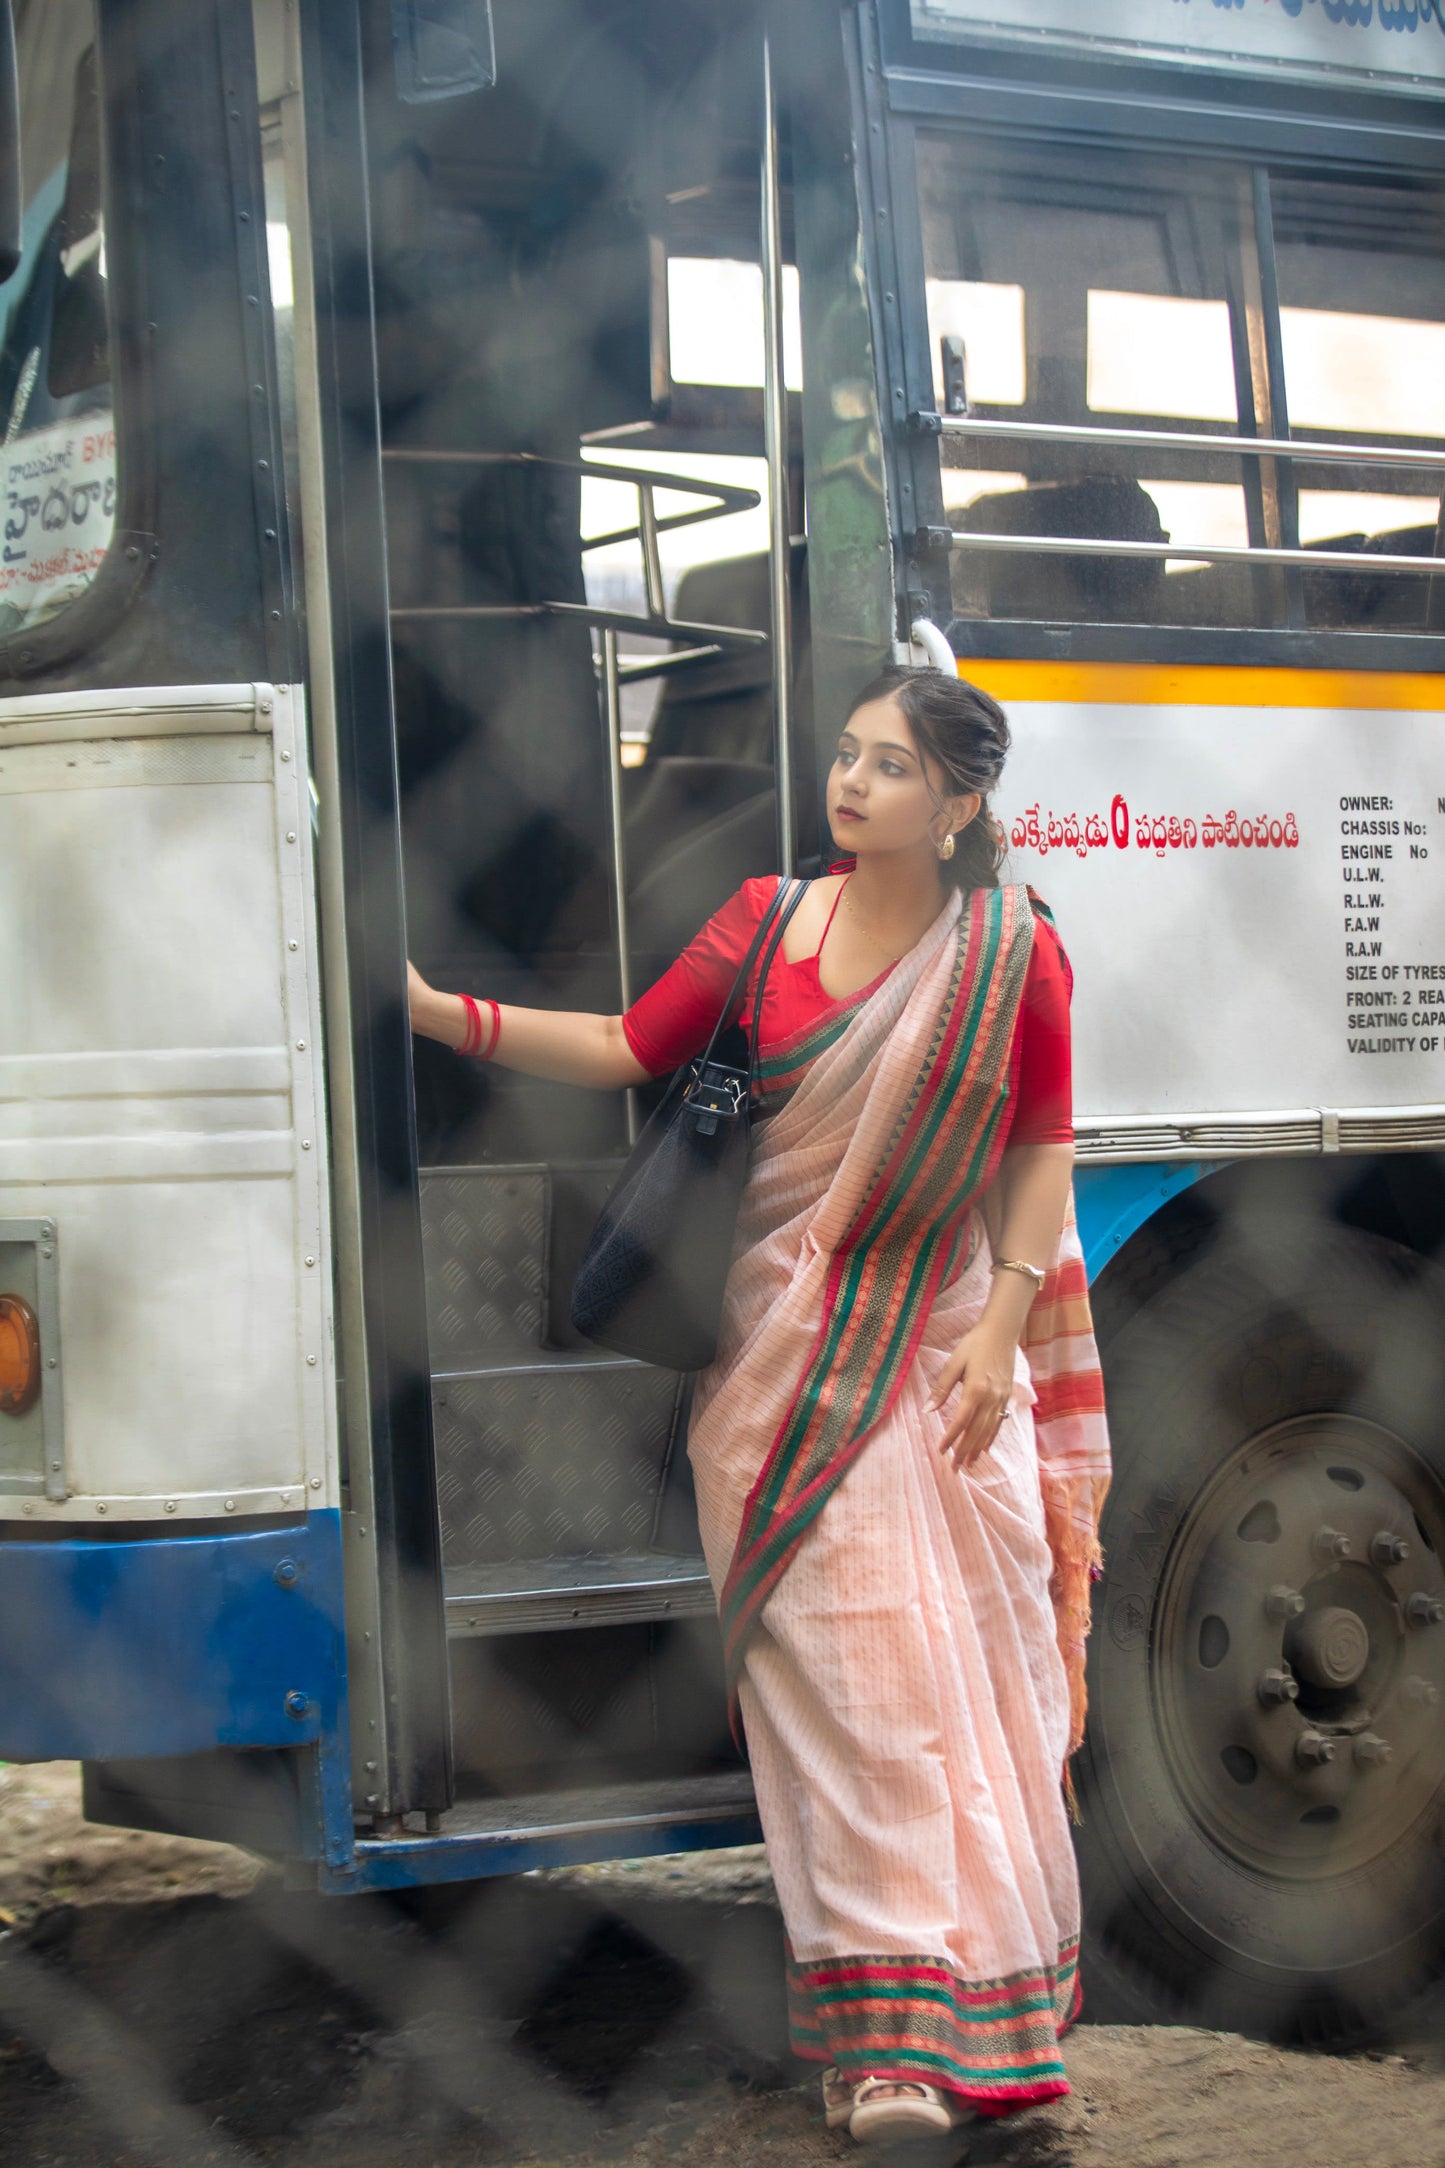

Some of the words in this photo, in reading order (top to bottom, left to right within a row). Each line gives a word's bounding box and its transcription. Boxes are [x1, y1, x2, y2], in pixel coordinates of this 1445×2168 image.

[1339, 796, 1394, 811] OWNER:
[1110, 793, 1130, 851] Q
[1341, 820, 1400, 836] CHASSIS
[1404, 821, 1427, 836] No:
[1341, 844, 1393, 860] ENGINE
[1410, 845, 1428, 860] No
[1343, 867, 1384, 883] U.L.W.
[1344, 893, 1384, 909] R.L.W.
[1344, 917, 1380, 933] F.A.W
[1345, 941, 1382, 957] R.A.W
[1346, 965, 1378, 981] SIZE
[1382, 965, 1400, 981] OF
[1403, 965, 1445, 981] TYRES
[1346, 991, 1398, 1007] FRONT:
[1402, 990, 1412, 1006] 2
[1347, 1012, 1408, 1030] SEATING
[1346, 1036, 1417, 1054] VALIDITY
[1419, 1036, 1439, 1052] OF
